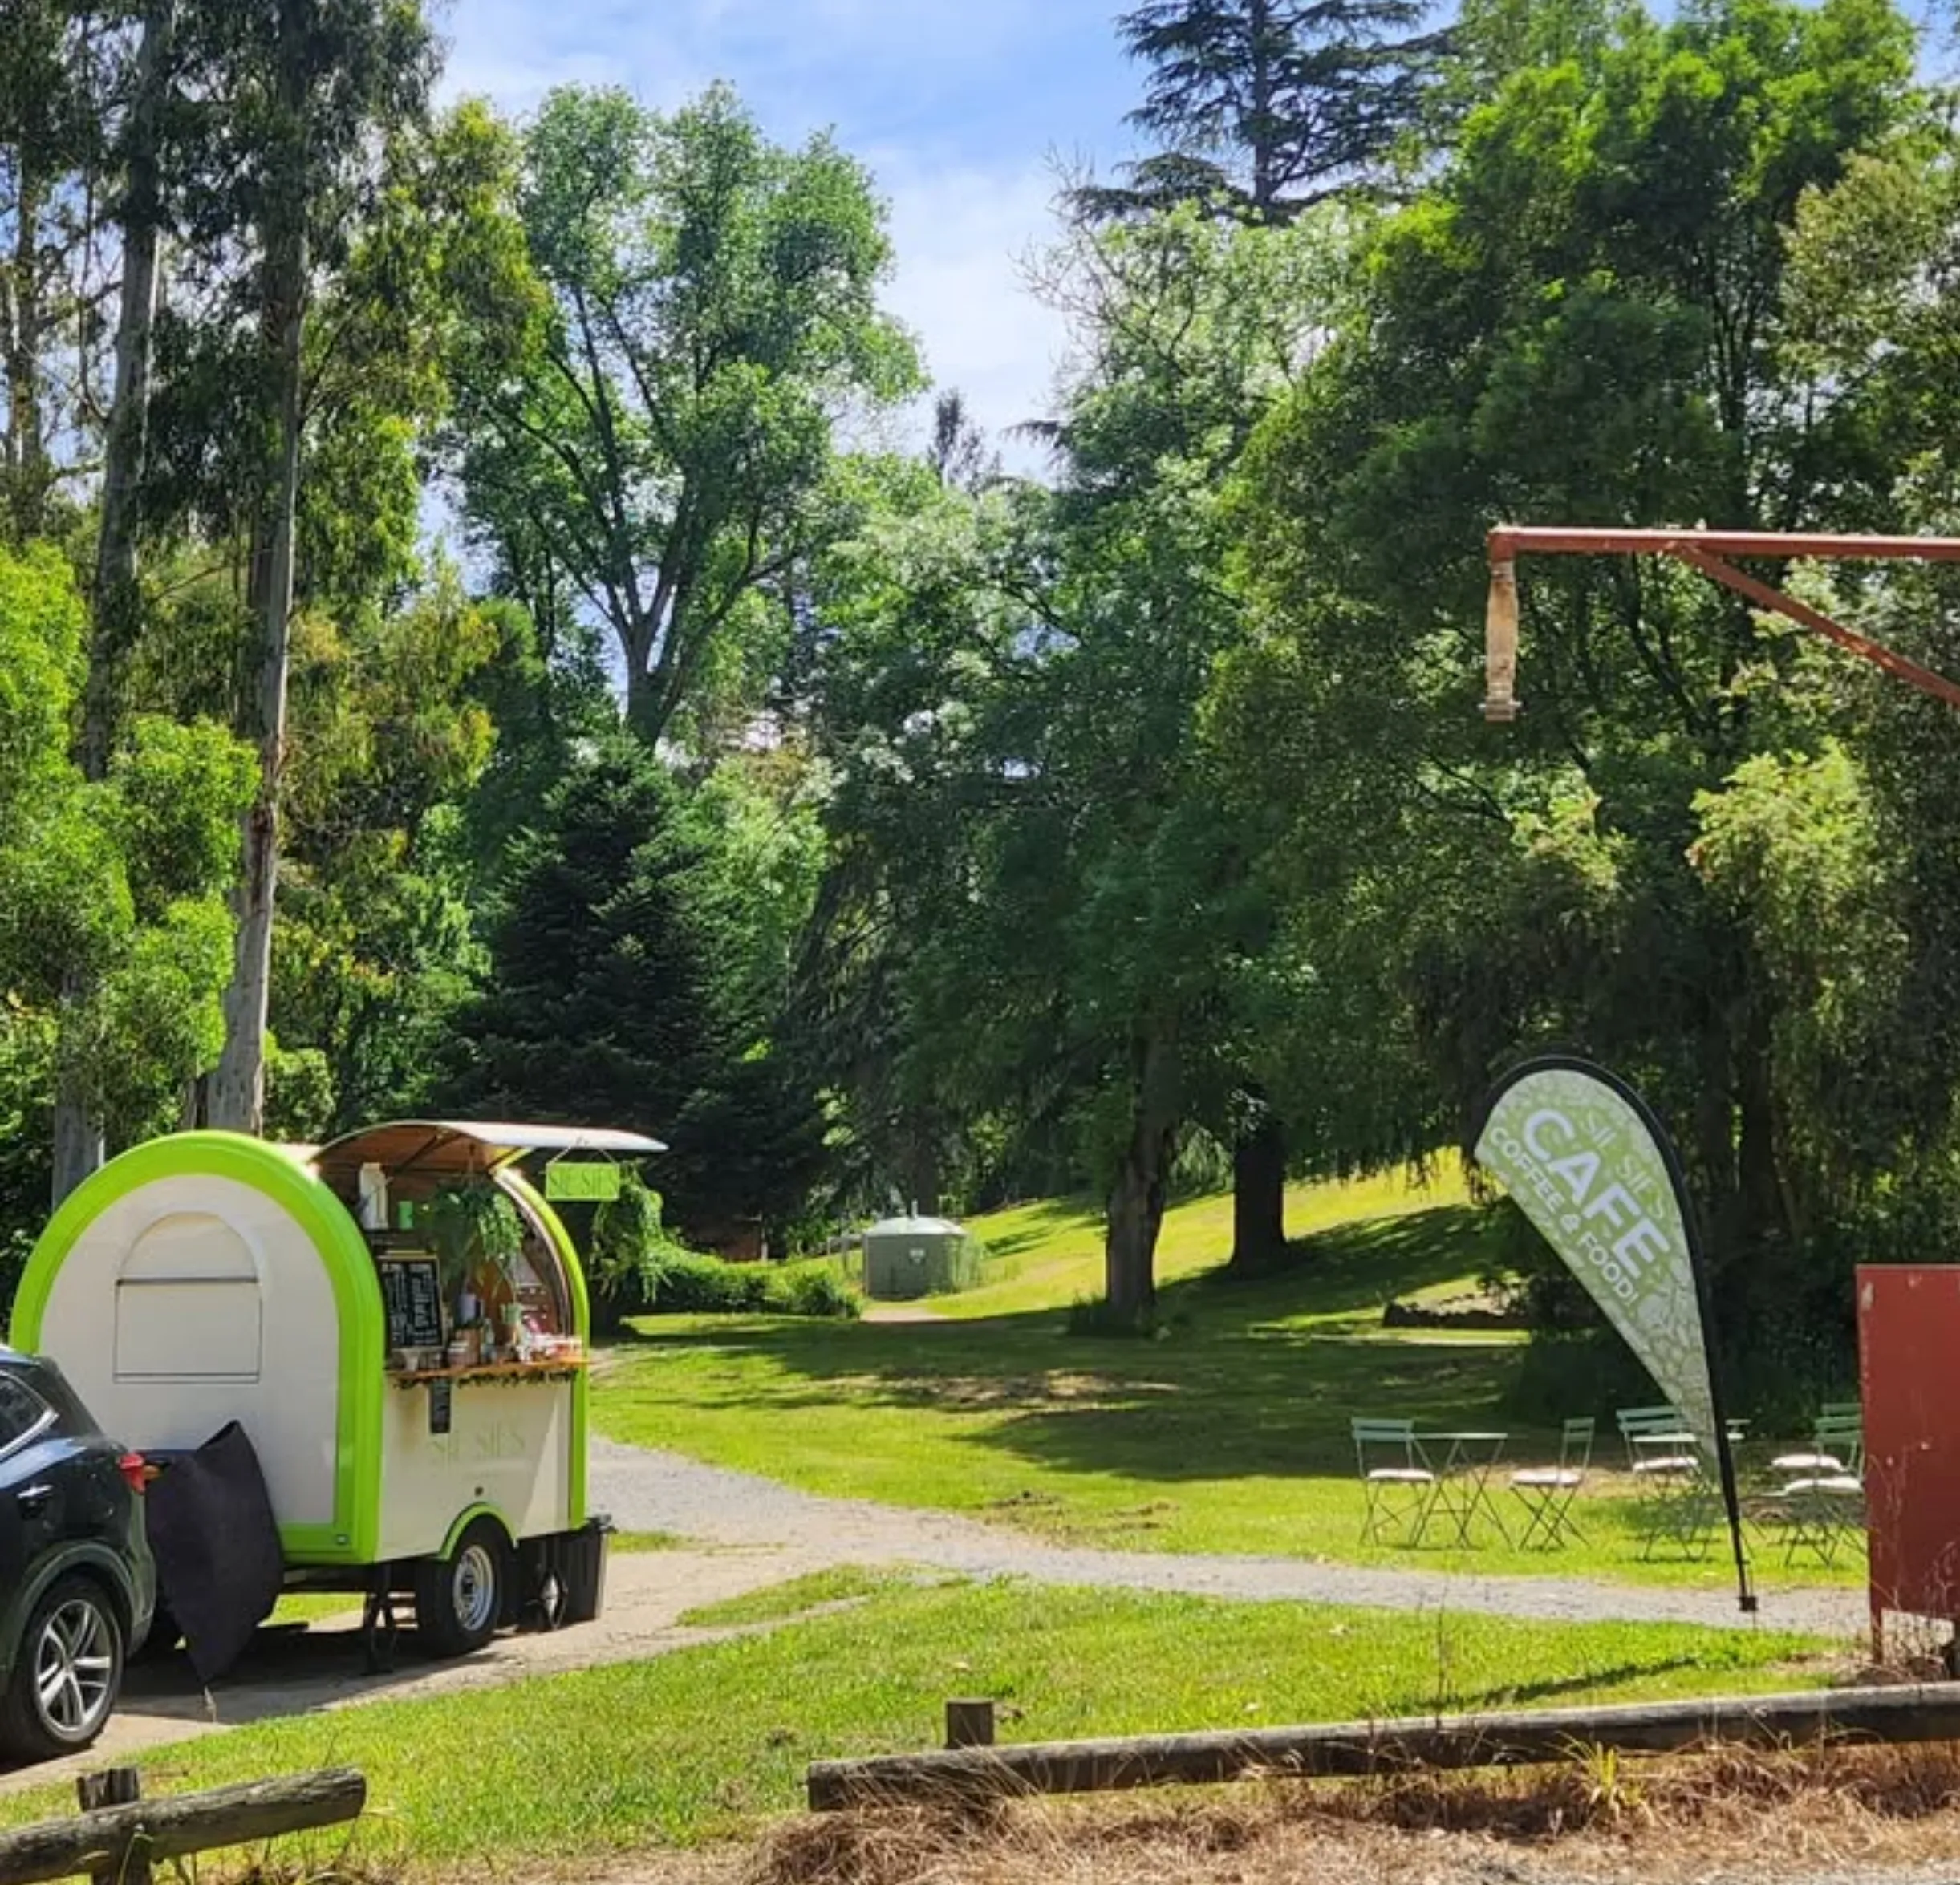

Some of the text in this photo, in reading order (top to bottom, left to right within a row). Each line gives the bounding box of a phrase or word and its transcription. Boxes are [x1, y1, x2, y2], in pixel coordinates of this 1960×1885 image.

[1490, 1127, 1565, 1213] COFFEE
[1560, 1214, 1581, 1234] &
[1524, 1109, 1670, 1279] CAFE
